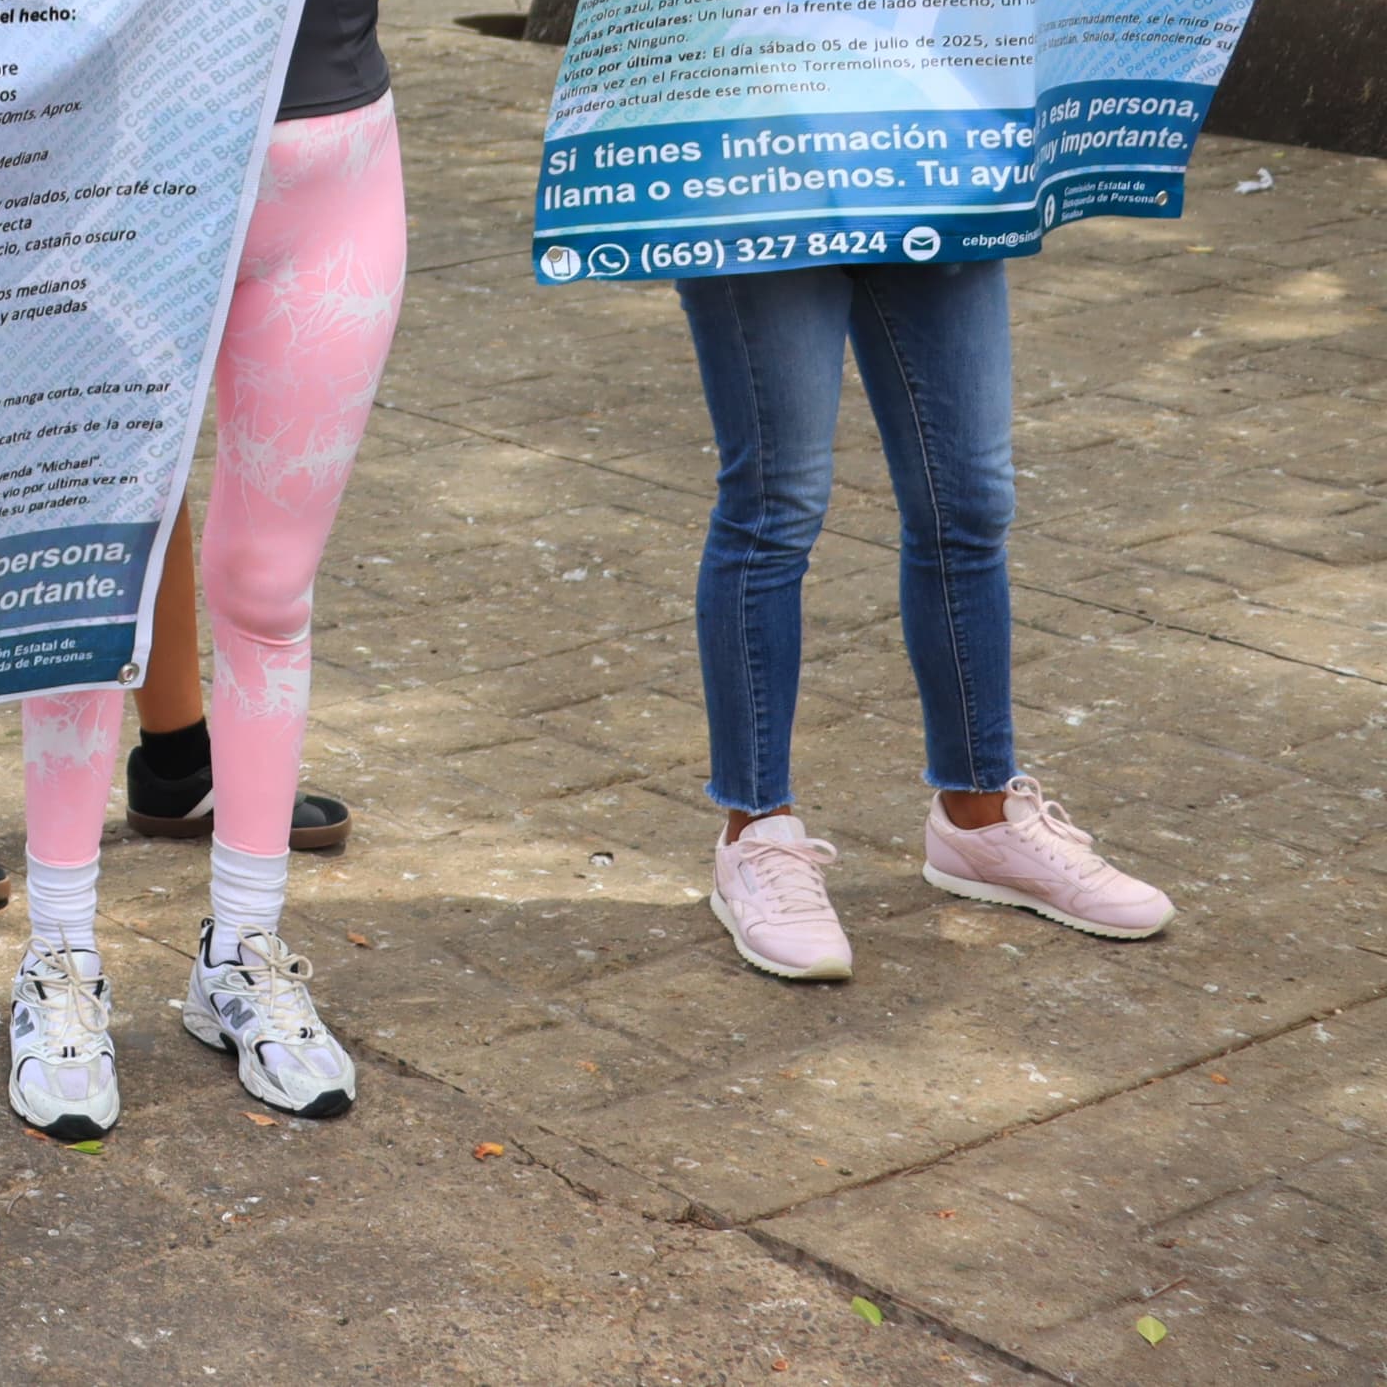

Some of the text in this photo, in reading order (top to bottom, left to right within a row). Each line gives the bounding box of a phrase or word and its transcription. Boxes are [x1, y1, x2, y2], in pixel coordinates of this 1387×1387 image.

[670, 57, 916, 83] Fraccionamiento Torremolinos,
[548, 148, 576, 176] Si
[595, 140, 702, 169] tienes
[722, 122, 947, 160] información
[1041, 111, 1047, 129] a
[1050, 97, 1079, 127] esta
[1088, 96, 1200, 122] persona,
[544, 181, 636, 211] llama
[648, 180, 671, 201] o
[683, 165, 906, 199] escribenos.
[916, 160, 960, 186] Tu
[971, 163, 1036, 192] ayu
[1060, 124, 1188, 155] importante.
[640, 230, 888, 273] (669) 327 8424
[221, 997, 256, 1030] N
